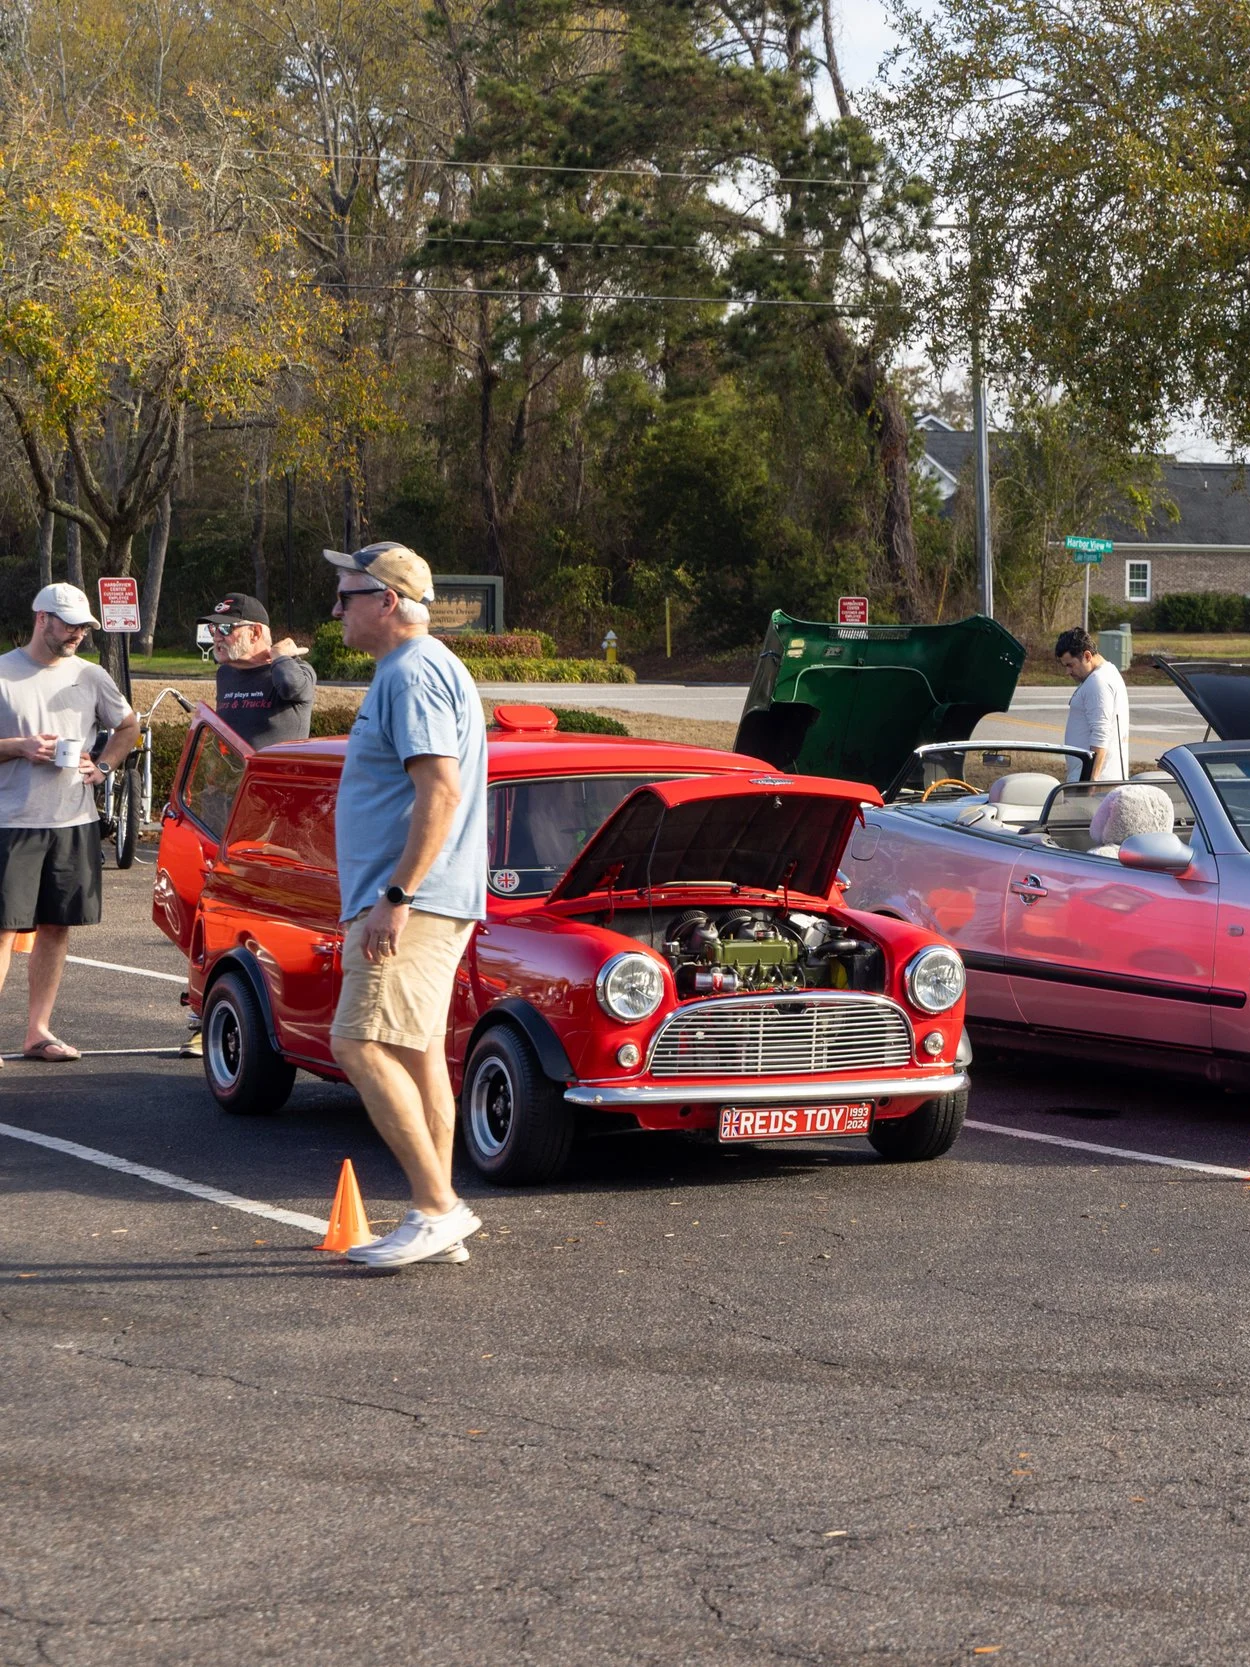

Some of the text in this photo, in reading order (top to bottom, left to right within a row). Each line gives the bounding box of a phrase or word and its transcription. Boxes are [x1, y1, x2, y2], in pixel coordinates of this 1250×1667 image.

[1067, 537, 1089, 550] Harbor
[1090, 540, 1105, 551] View
[233, 691, 249, 699] plays
[250, 690, 264, 698] with
[241, 699, 272, 709] Trucks
[849, 1107, 869, 1117] 1993
[739, 1108, 845, 1135] REDS TOY
[846, 1119, 868, 1130] 2024
